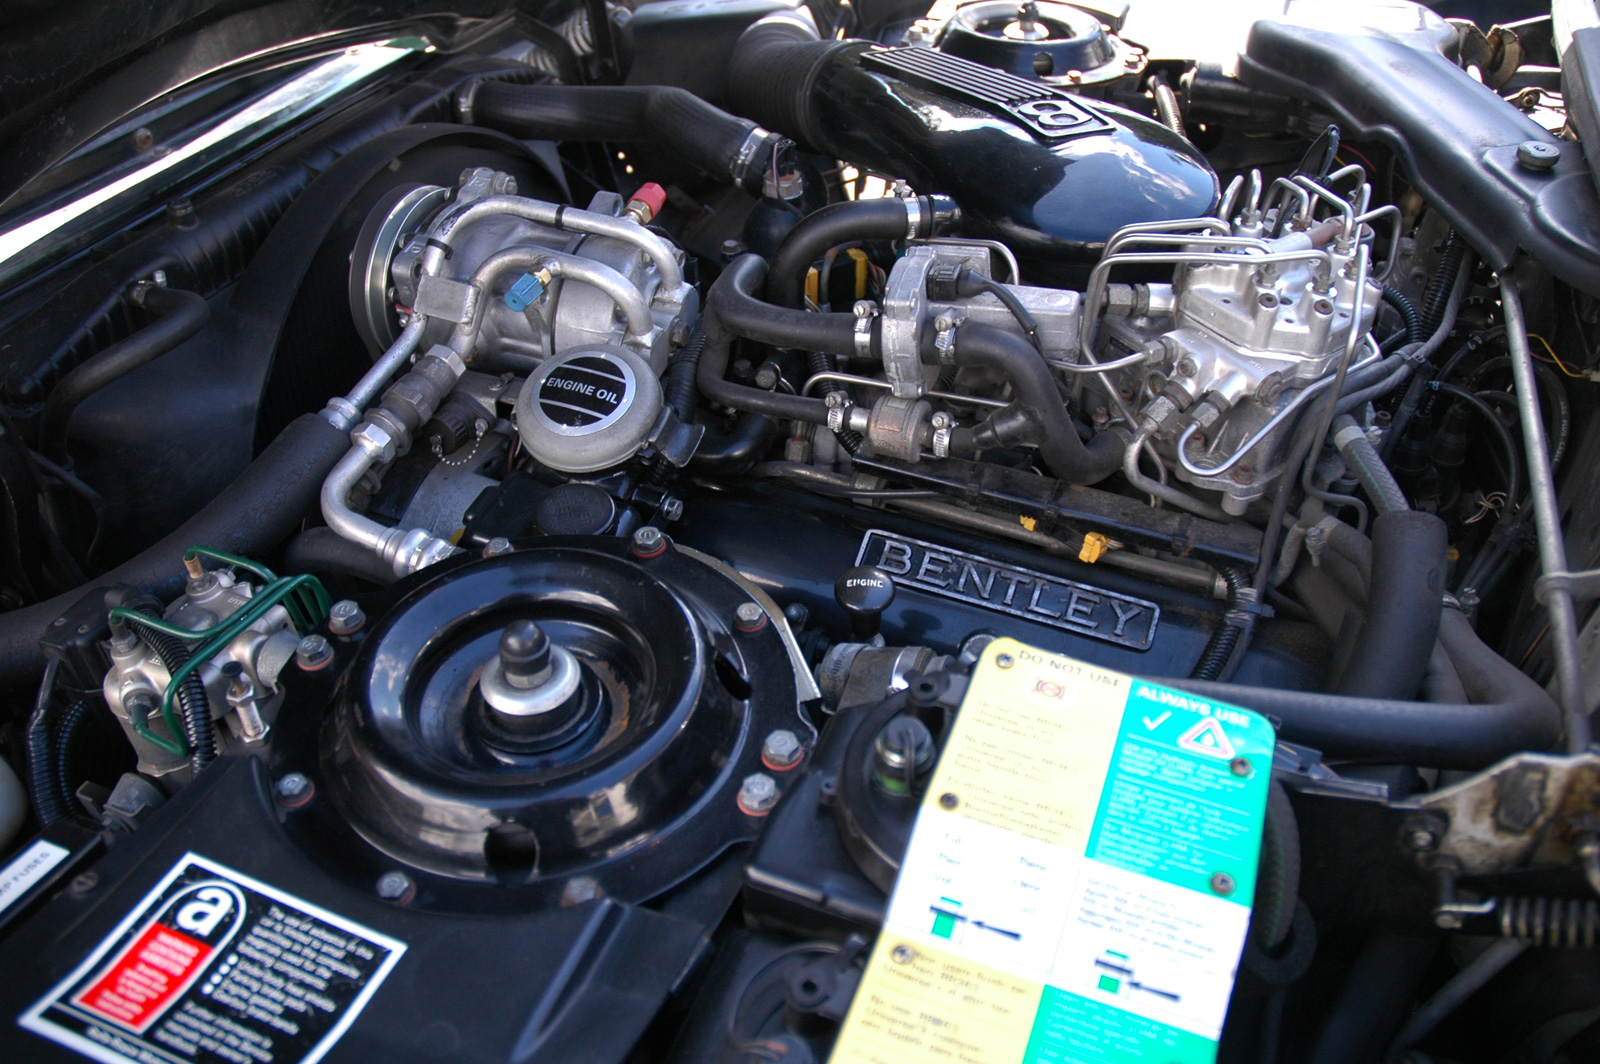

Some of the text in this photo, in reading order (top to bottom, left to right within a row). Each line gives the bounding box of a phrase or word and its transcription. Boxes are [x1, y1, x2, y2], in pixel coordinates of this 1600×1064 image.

[546, 377, 618, 404] ENGINE OIL
[846, 579, 884, 588] ENGINE
[875, 539, 1143, 637] BENTLEY
[1018, 650, 1043, 664] DO
[1050, 659, 1083, 676] NOT
[1136, 686, 1252, 728] ALWAYS USE
